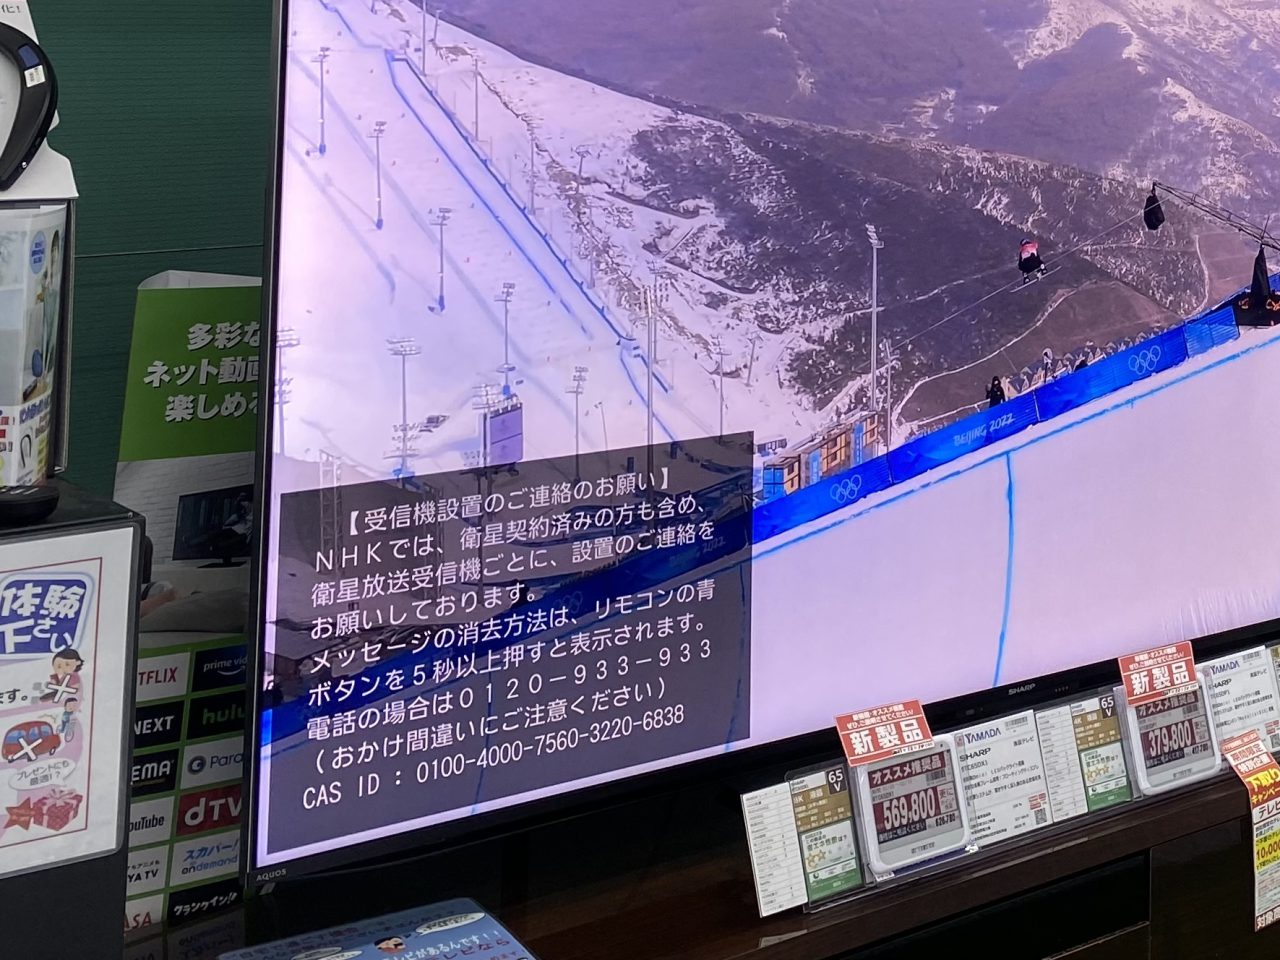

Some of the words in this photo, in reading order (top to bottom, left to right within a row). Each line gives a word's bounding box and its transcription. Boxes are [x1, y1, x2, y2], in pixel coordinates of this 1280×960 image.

[953, 422, 988, 447] BEIJING
[989, 413, 1016, 434] 2022
[346, 467, 669, 536] 【受信機設置のご連絡のお願い】
[315, 497, 708, 573] NHKでは、衛星契約済みの方も含め、
[311, 521, 714, 609] 衛星放送受信機ごとに、設置のご連絡を
[1, 582, 85, 619] 体験
[310, 583, 541, 640] お願いしております。
[0, 618, 73, 654] 下さい
[310, 578, 715, 675] メッセージの消去方法は、リモコンの青
[203, 660, 231, 673] prime
[308, 615, 707, 708] ボタンを5秒以上押すと表示されます。
[1210, 660, 1240, 675] YAMADA
[1008, 683, 1036, 696] SHARP
[1131, 661, 1190, 696] 新製品
[1101, 696, 1114, 708] 65
[849, 718, 924, 756] 新製品
[965, 727, 1001, 745] YAMADA
[1149, 720, 1192, 758] 379,800
[303, 783, 342, 810] CAS
[359, 774, 380, 798] ID
[416, 704, 685, 784] 0100-4000-7560-3220-6838
[959, 747, 991, 762] SHARP
[1230, 744, 1263, 762] 期間限定
[17, 760, 69, 782] プレゼントにも
[828, 769, 843, 783] 65
[872, 754, 942, 785] オススメ推奨品
[184, 797, 241, 827] dTV
[883, 789, 936, 830] 569,800
[181, 855, 237, 875] ondemand
[256, 868, 287, 883] AQUOS
[174, 892, 237, 916] クランクイン!!
